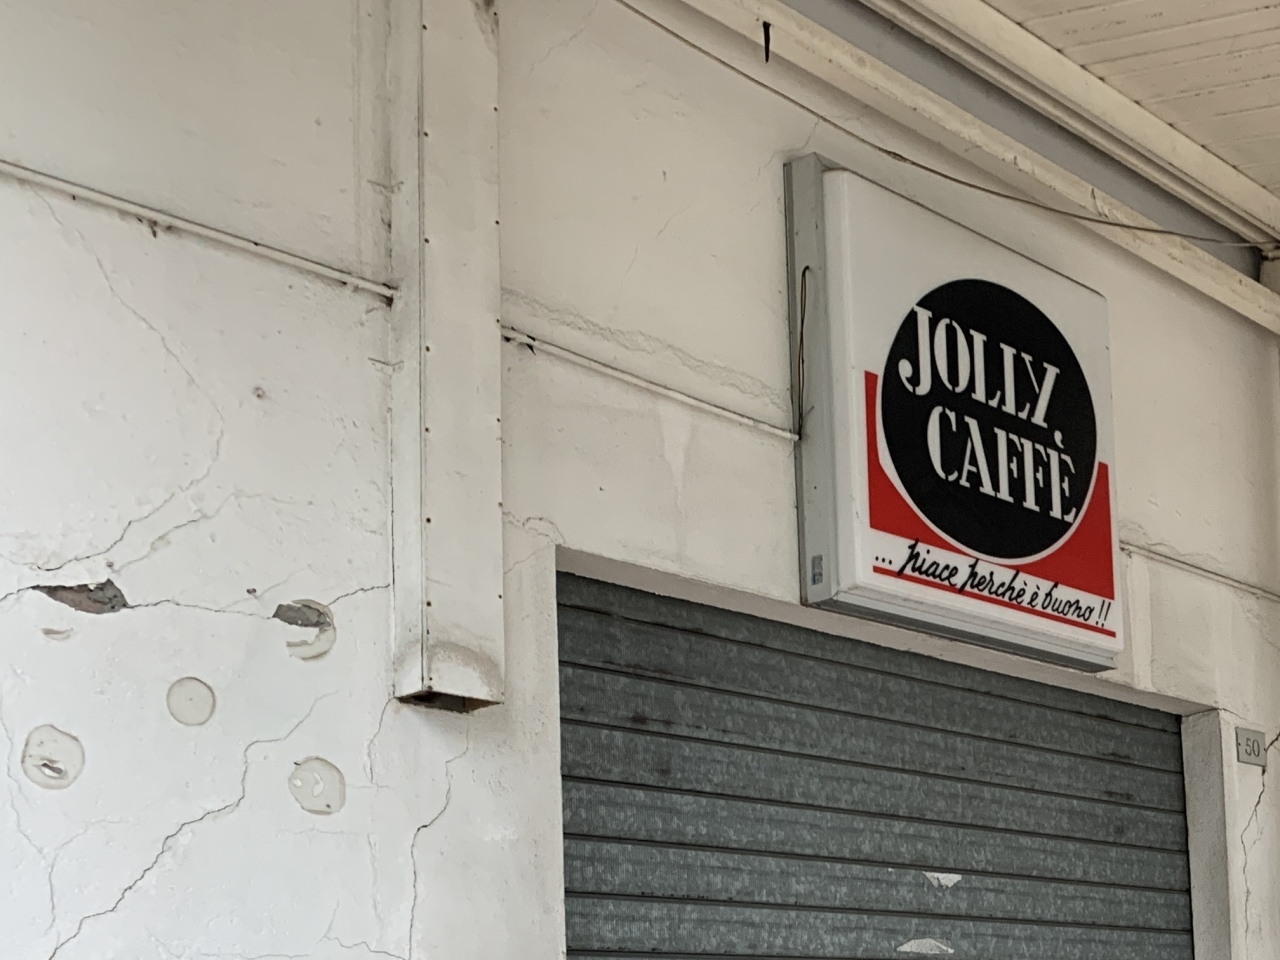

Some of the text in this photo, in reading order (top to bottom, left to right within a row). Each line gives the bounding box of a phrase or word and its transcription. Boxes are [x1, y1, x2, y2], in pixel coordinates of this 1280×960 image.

[898, 304, 1061, 429] JOLLY
[926, 405, 1077, 524] CAFFÈ
[1027, 584, 1041, 608] è
[1244, 738, 1260, 757] 50
